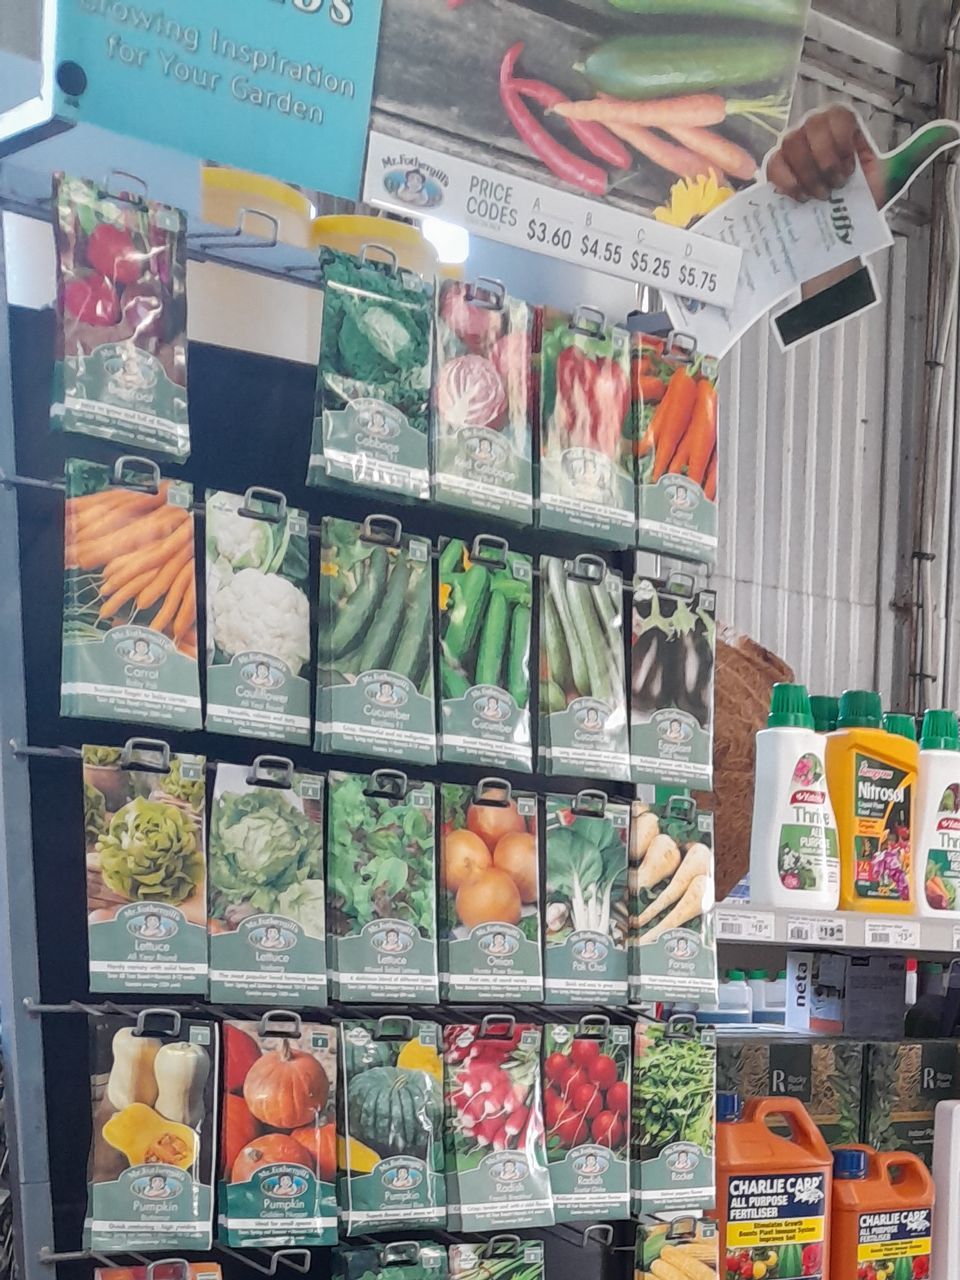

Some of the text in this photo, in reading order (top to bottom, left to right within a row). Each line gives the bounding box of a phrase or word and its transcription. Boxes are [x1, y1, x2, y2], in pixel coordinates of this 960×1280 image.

[211, 28, 356, 97] Inspiration
[108, 35, 324, 124] for Your Garden
[469, 175, 513, 204] PRICE
[466, 197, 518, 227] CODES
[533, 197, 693, 257] A B C D
[527, 219, 717, 292] $3.60 $4.55 $5.25 $5.75
[123, 664, 159, 680] Carrot
[858, 781, 905, 804] Nitrosol
[135, 940, 170, 952] Lettuce
[255, 951, 290, 963] Lettuce
[377, 954, 407, 965] Lettuce
[795, 962, 808, 1008] neta
[773, 1070, 786, 1092] R
[923, 1068, 935, 1089] R
[730, 1178, 785, 1195] CHARLIE
[133, 1201, 178, 1213] Pumpkin
[263, 1199, 305, 1210] Pumpkin
[730, 1195, 788, 1208] ALL PURPOSE
[730, 1208, 778, 1220] FERTILISER
[859, 1214, 900, 1227] CHARLIE
[859, 1227, 872, 1236] ALL
